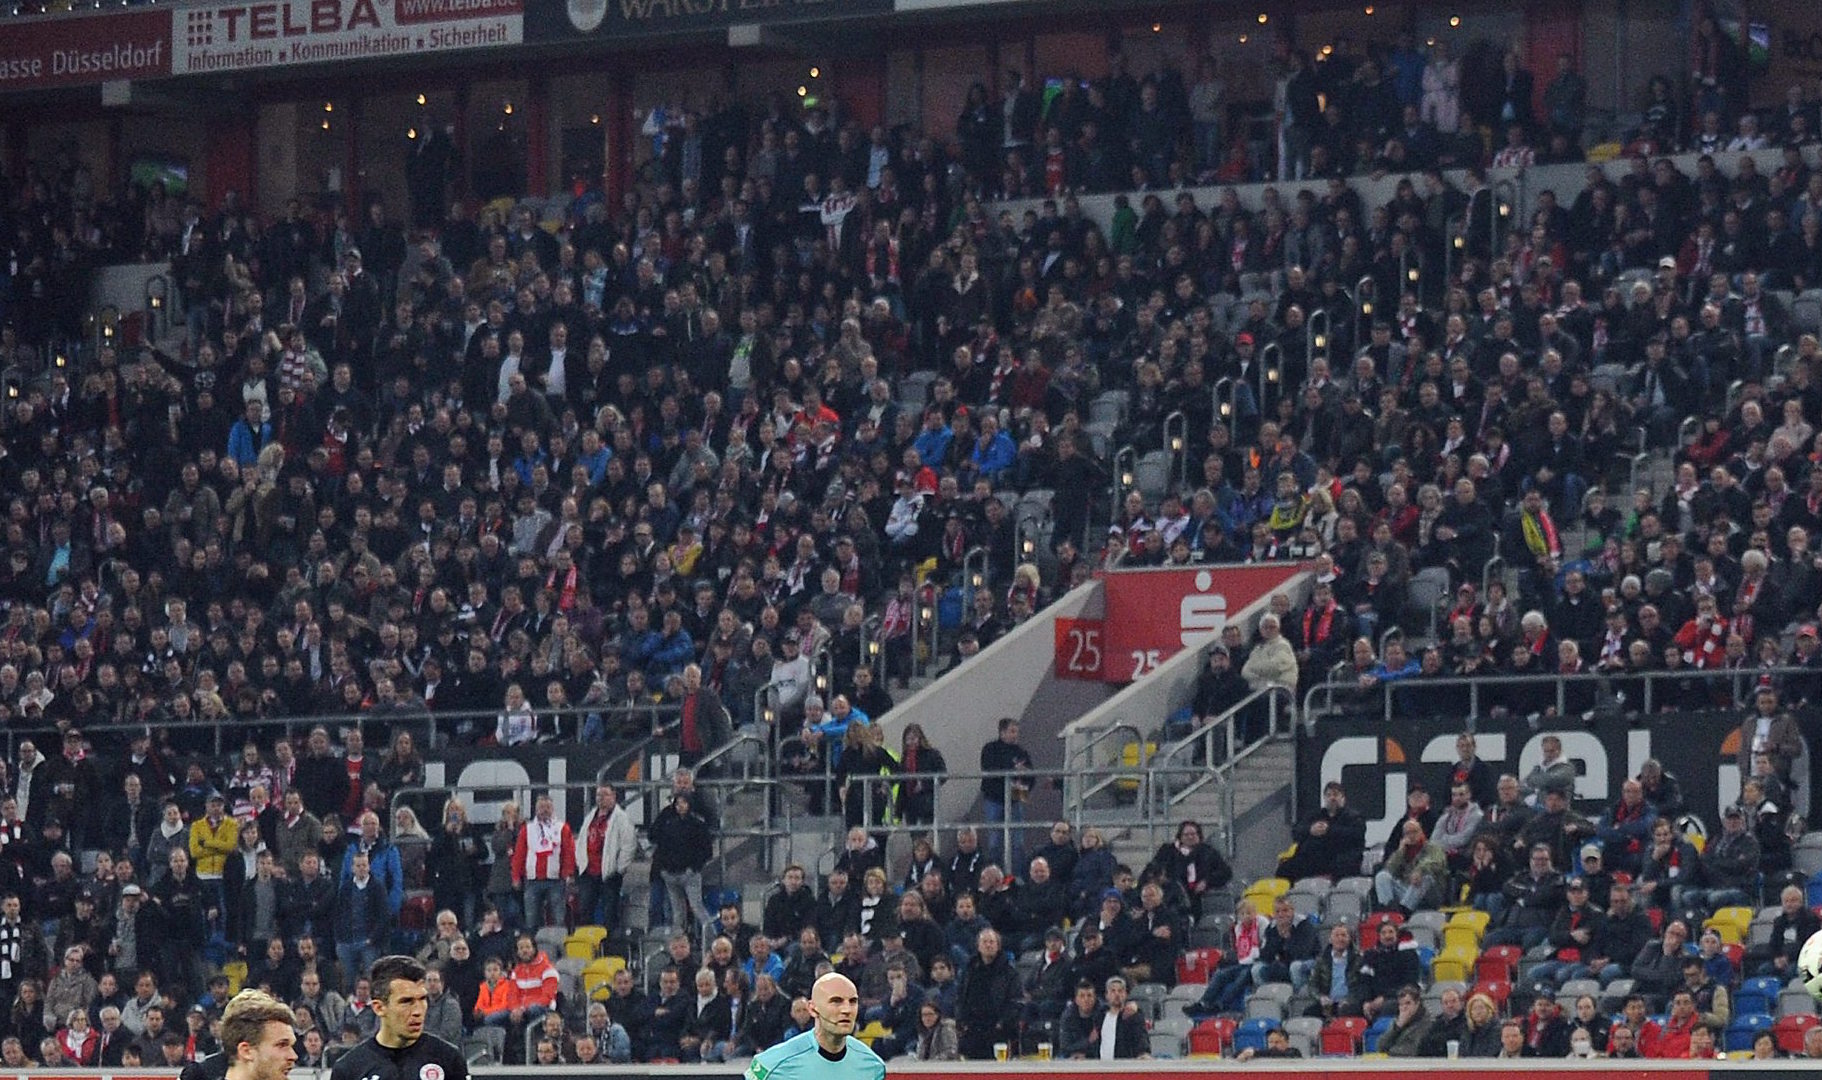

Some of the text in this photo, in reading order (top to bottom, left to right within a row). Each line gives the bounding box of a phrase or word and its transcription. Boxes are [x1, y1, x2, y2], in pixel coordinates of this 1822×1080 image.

[218, 0, 382, 42] TELBA
[53, 40, 163, 76] Düsseldorf
[187, 23, 508, 71] Information Kommunikation Sicherheit
[1069, 630, 1101, 673] 25
